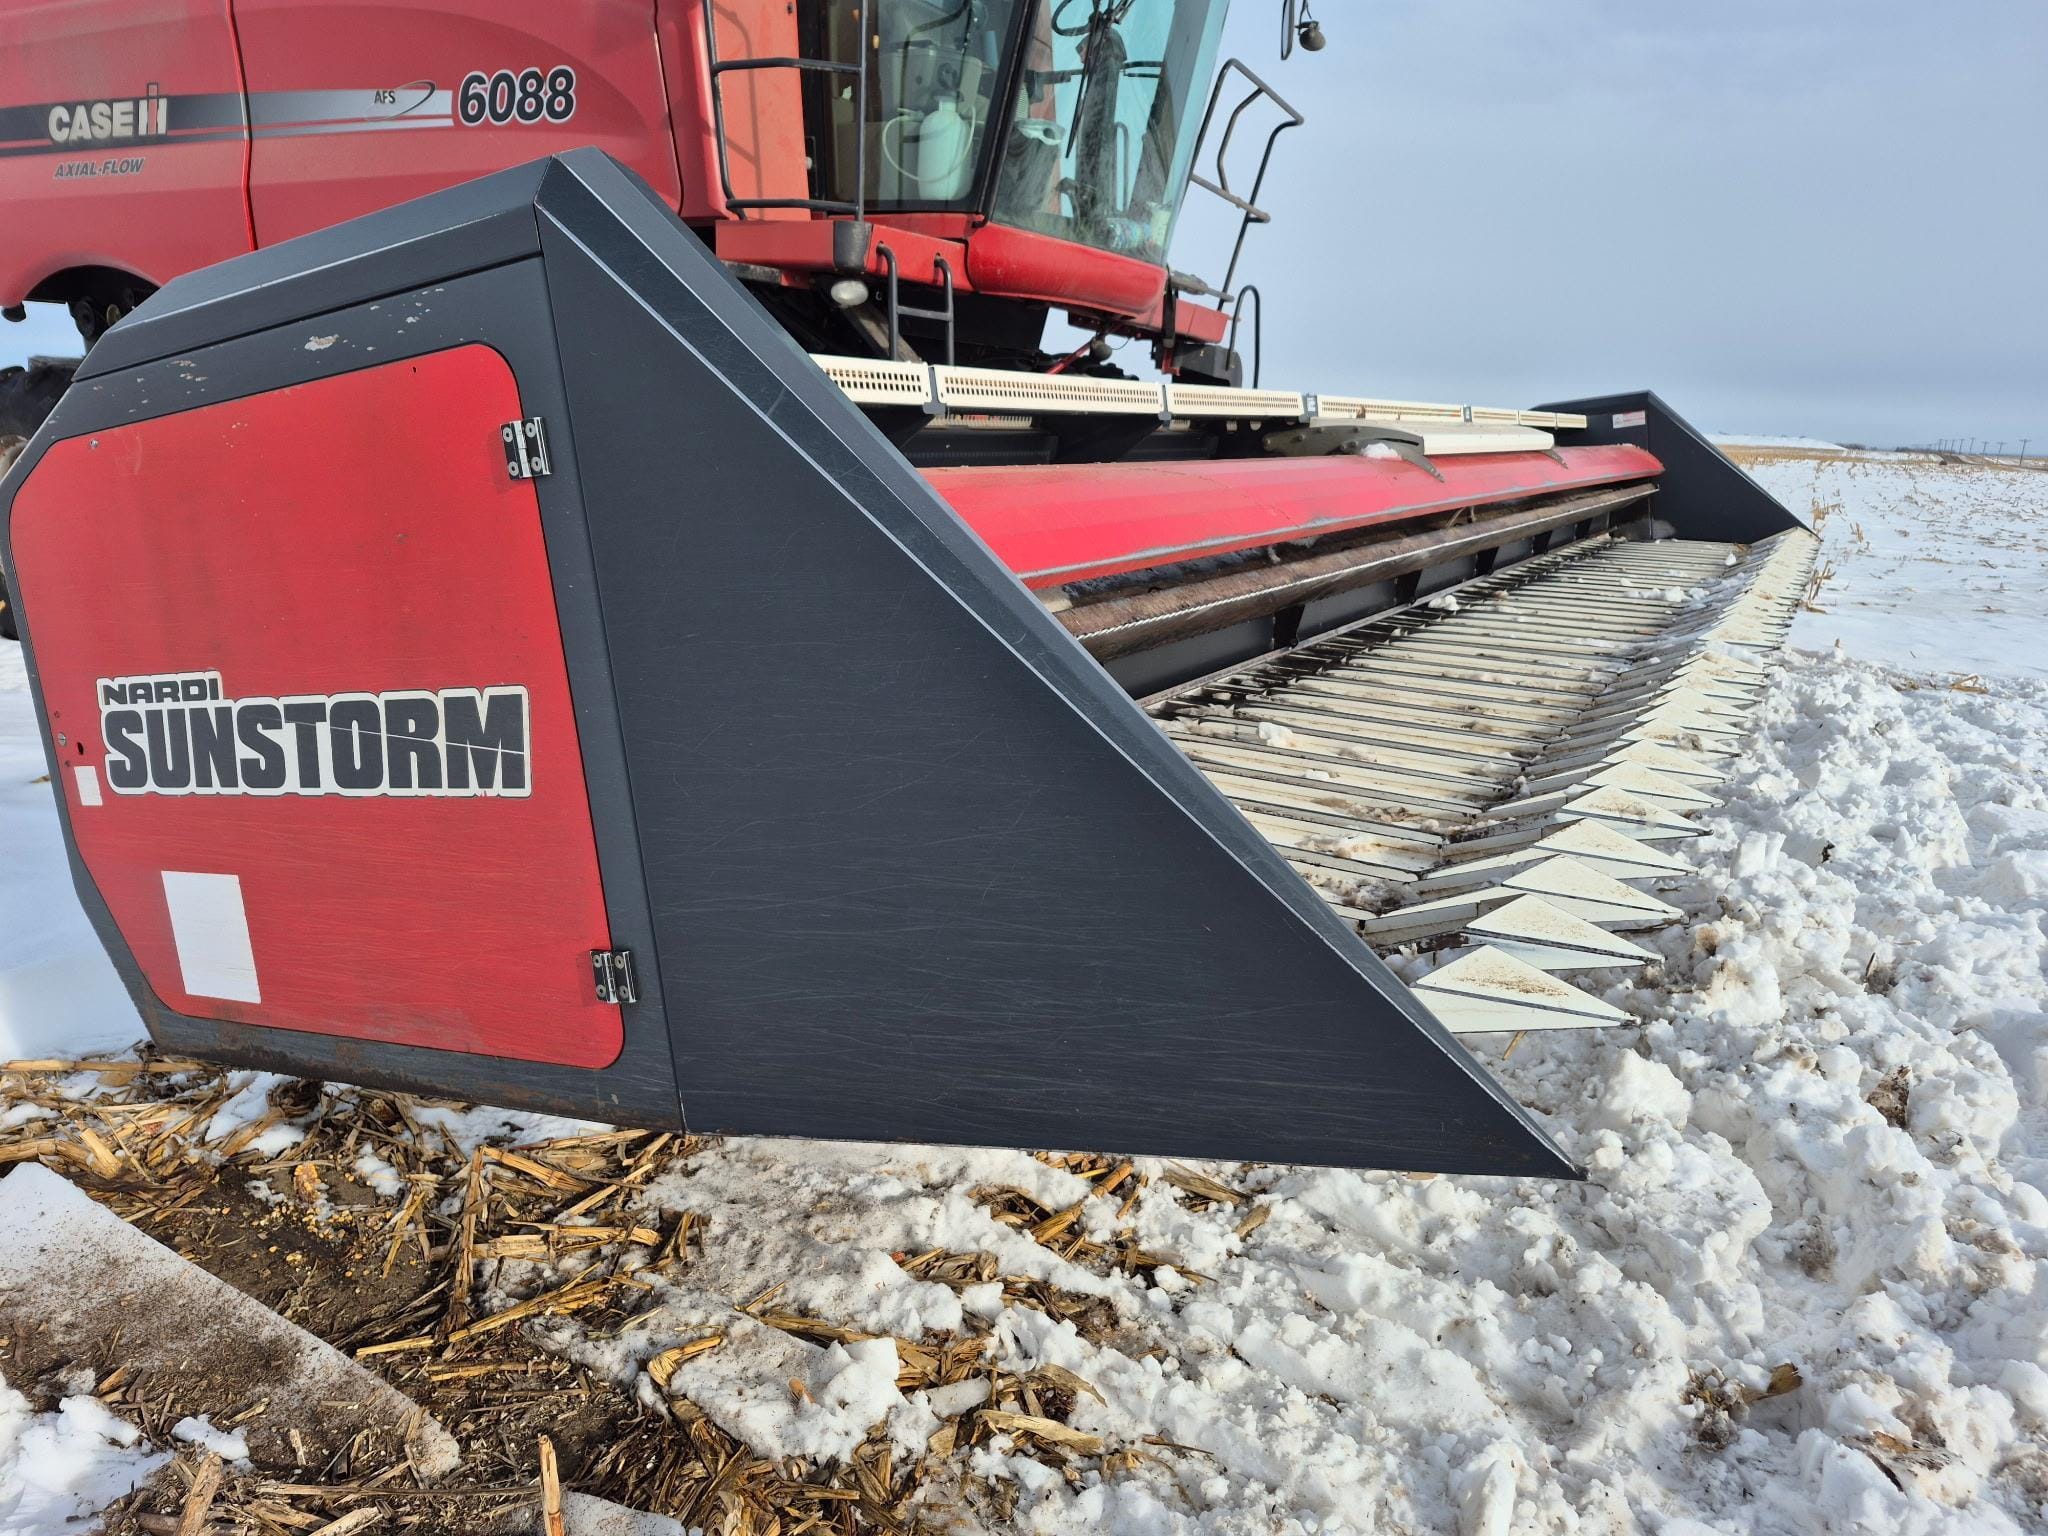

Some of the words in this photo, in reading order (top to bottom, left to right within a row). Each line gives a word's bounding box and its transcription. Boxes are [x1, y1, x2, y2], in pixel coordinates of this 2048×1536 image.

[374, 90, 396, 104] AFS
[458, 66, 576, 126] 6088
[48, 101, 134, 143] CASE
[54, 158, 145, 178] AXIAL-FLOW
[103, 678, 219, 705] NARDI
[104, 694, 526, 789] SUNSTORM
